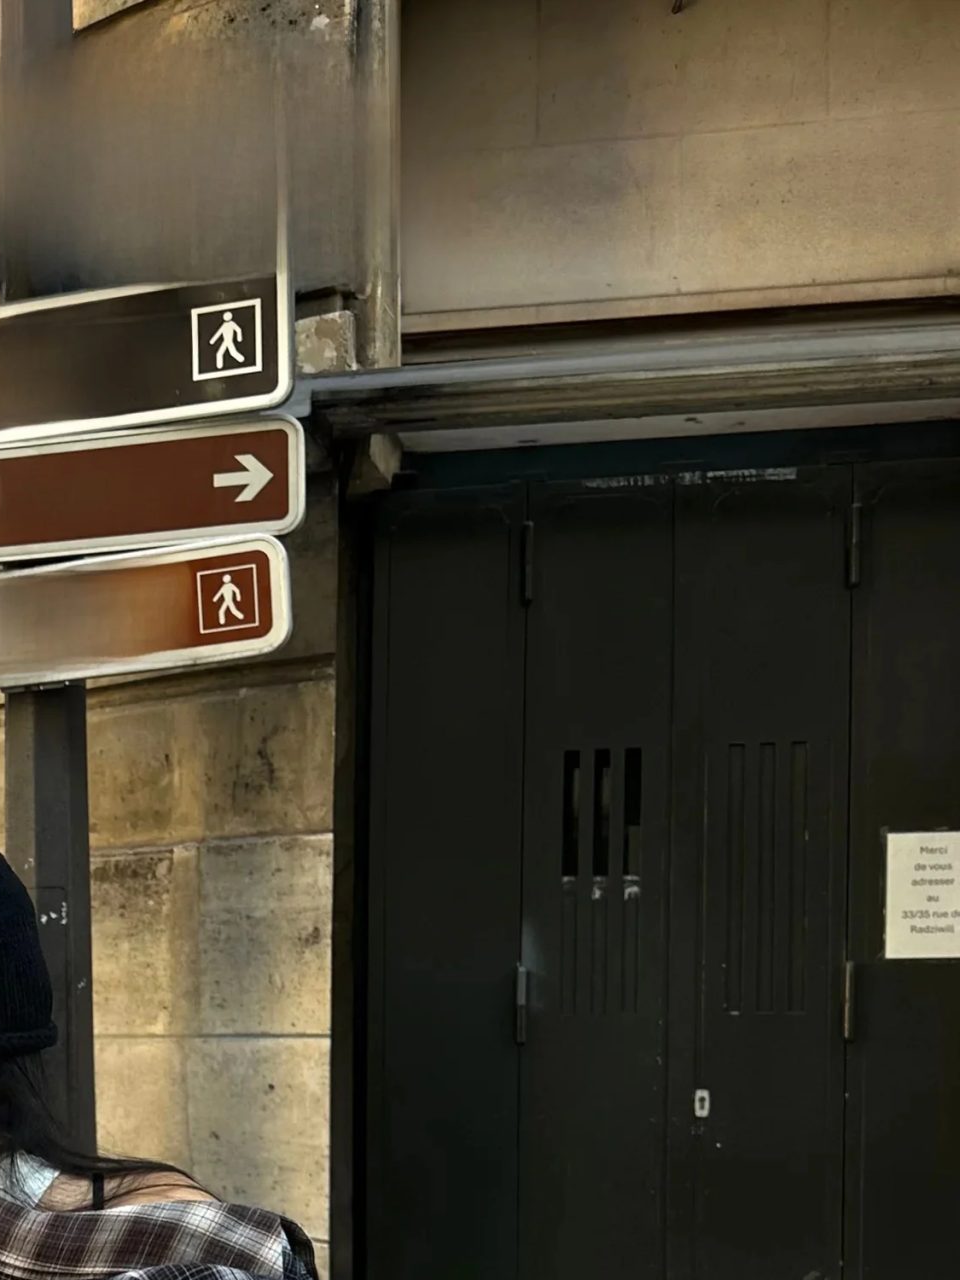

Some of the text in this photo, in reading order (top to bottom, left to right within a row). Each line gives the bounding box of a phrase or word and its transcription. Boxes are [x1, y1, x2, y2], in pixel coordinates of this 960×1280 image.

[919, 845, 948, 855] Merci
[913, 863, 953, 871] de vous
[911, 878, 955, 886] adresser
[932, 911, 949, 919] rue
